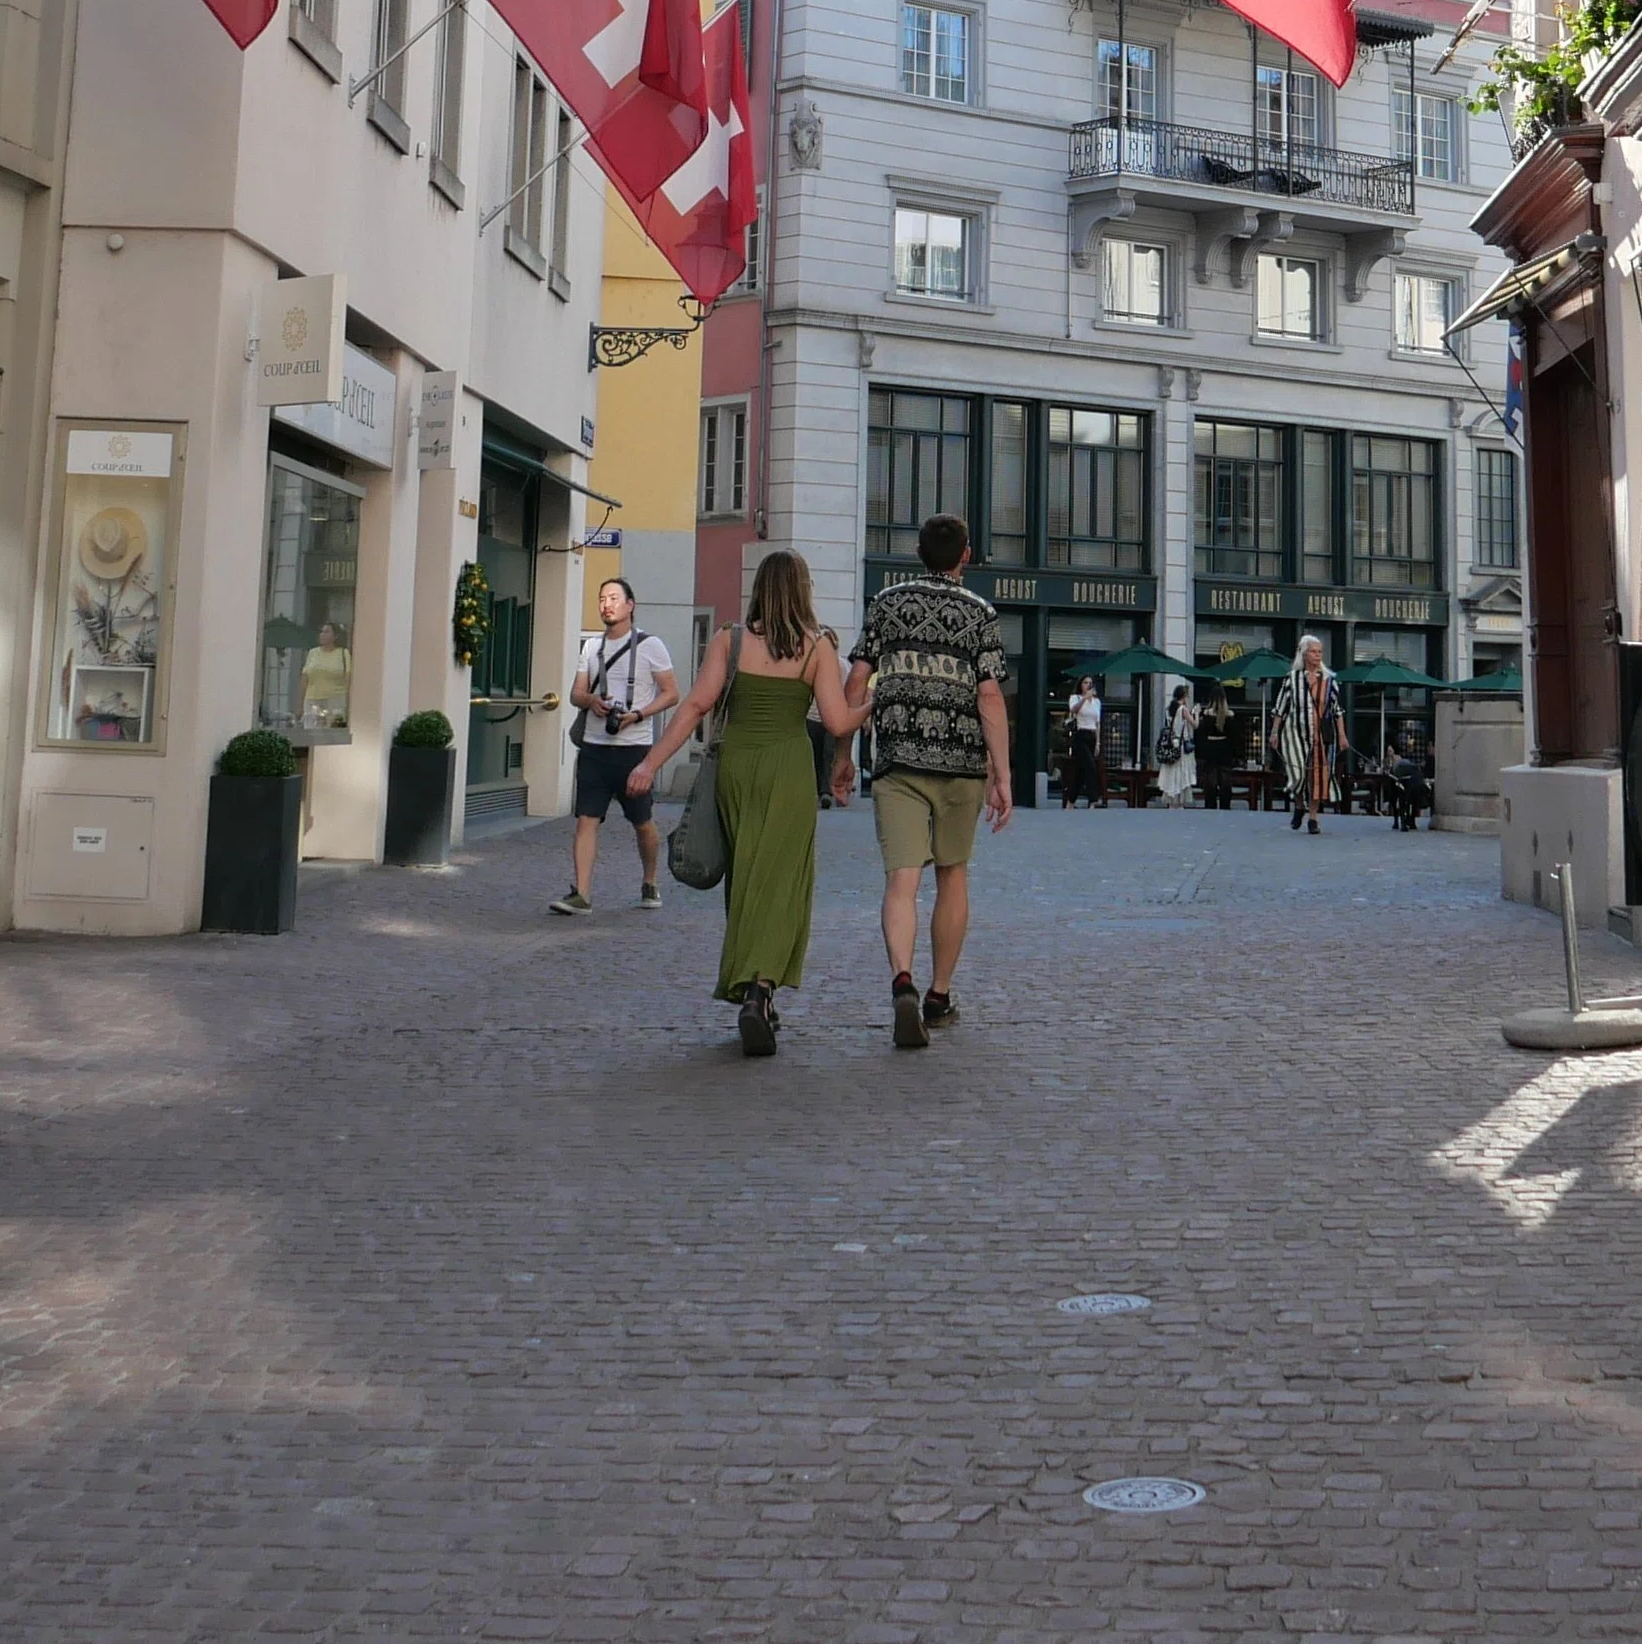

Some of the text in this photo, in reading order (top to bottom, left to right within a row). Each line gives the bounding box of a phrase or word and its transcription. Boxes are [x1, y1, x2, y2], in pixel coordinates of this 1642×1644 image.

[264, 362, 292, 377] COUP
[1073, 582, 1136, 605] BOUCHERIE
[1211, 589, 1281, 612] RESTAURANT
[1375, 598, 1430, 620] BOUCHERIE
